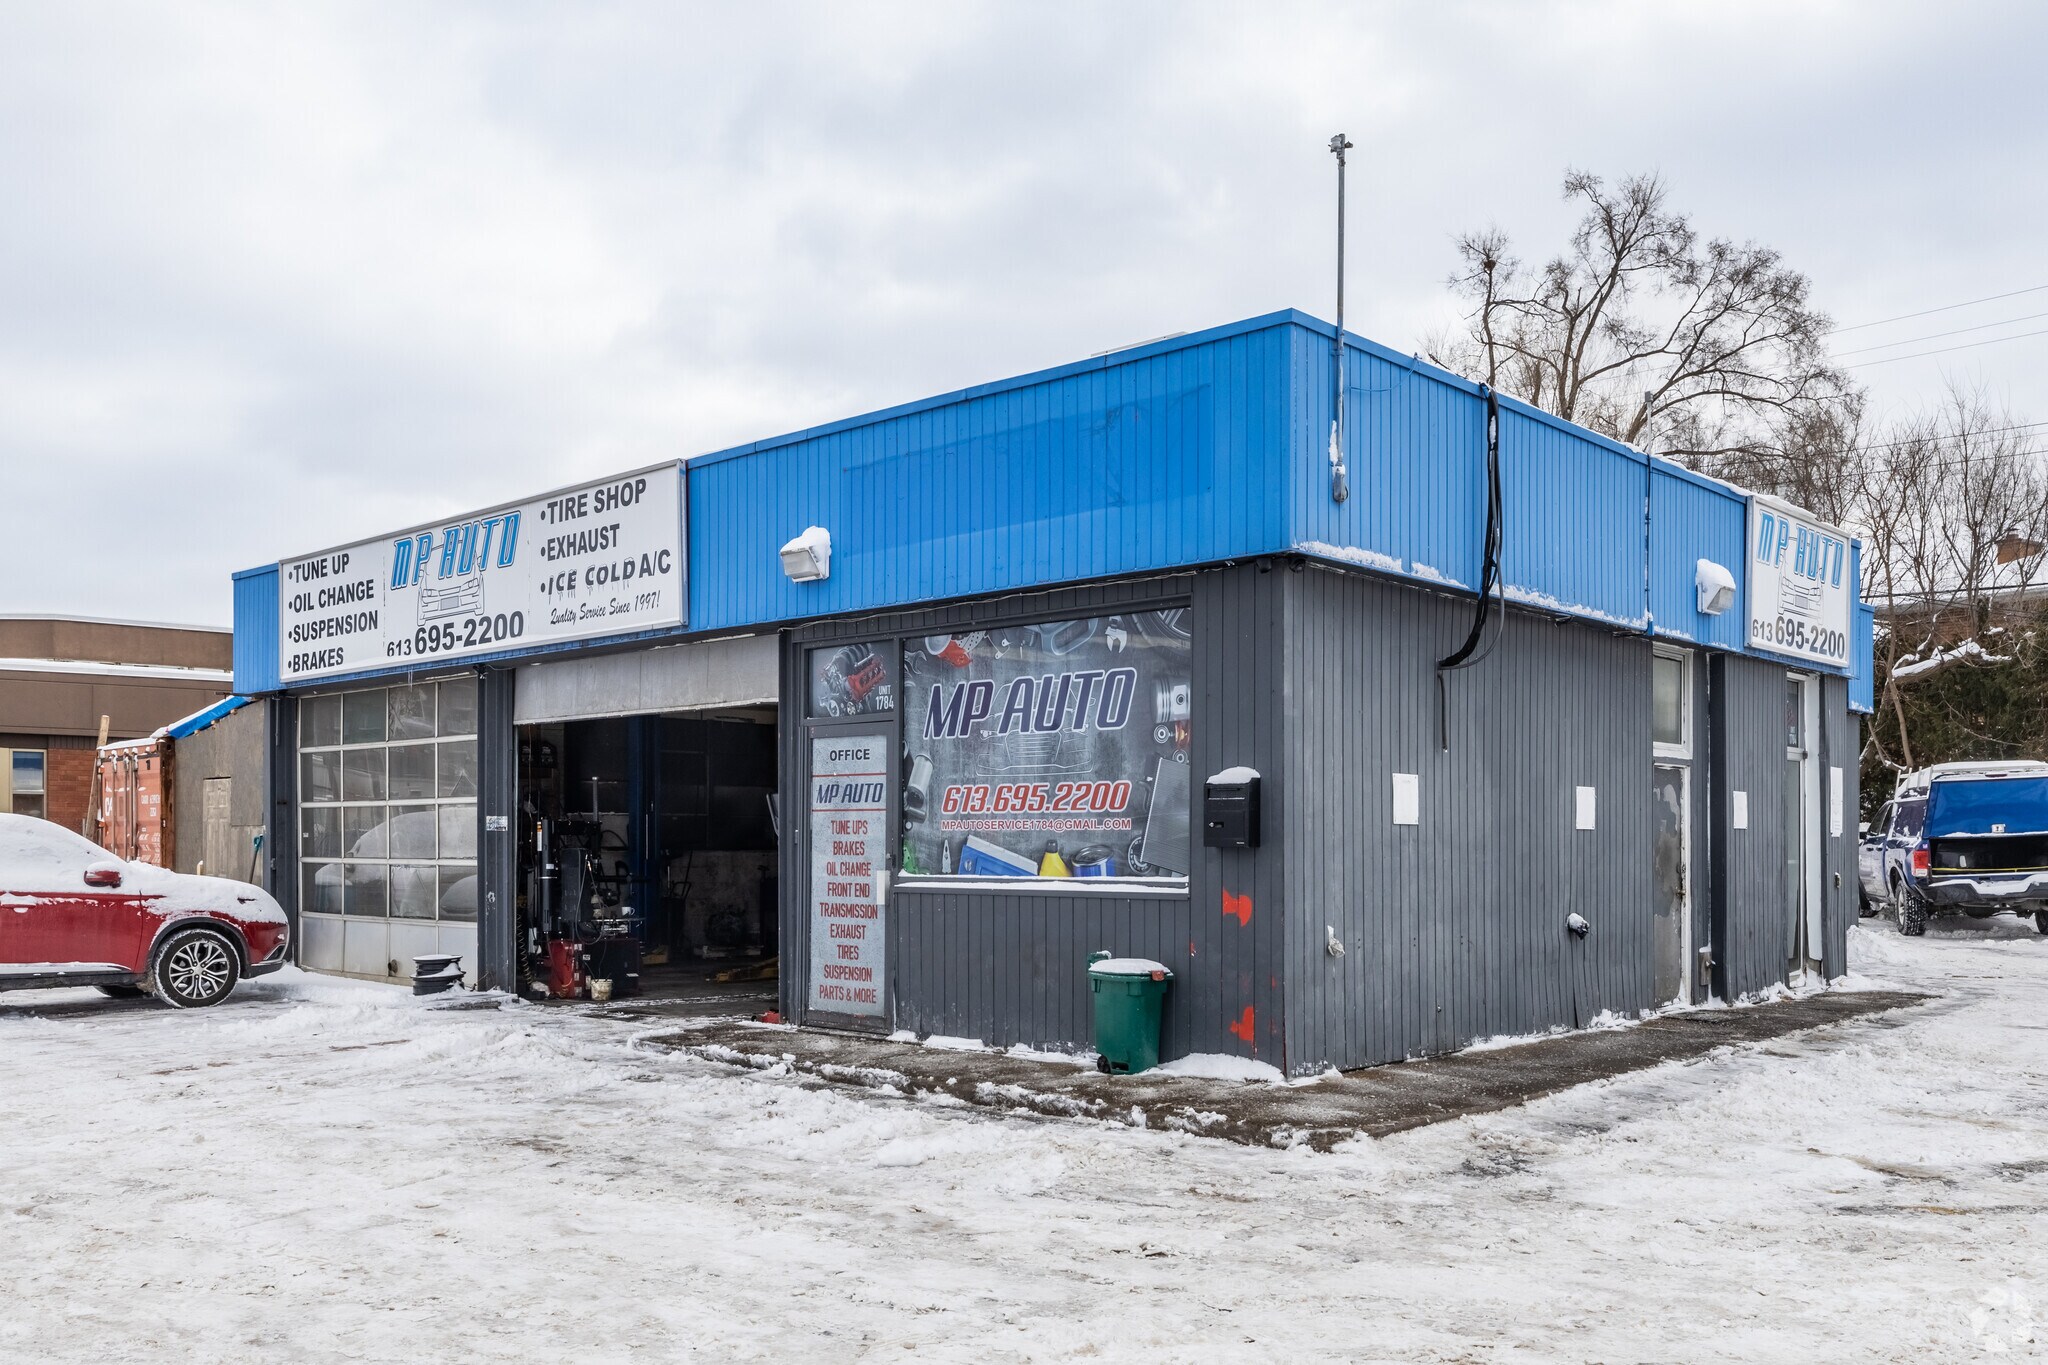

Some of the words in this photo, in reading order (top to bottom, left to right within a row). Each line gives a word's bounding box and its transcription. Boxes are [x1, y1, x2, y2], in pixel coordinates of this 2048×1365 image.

[547, 493, 588, 525] TIRE
[593, 478, 647, 514] SHOP
[390, 532, 433, 590] MP
[438, 510, 521, 580] AUTO
[547, 523, 620, 562] EXHAUST
[1756, 508, 1790, 569] MP
[1793, 522, 1845, 590] AUTO
[293, 558, 328, 583] TUNE
[332, 553, 350, 575] UP
[548, 569, 578, 596] ICE
[584, 557, 636, 587] COLD
[638, 549, 672, 579] A/C
[293, 592, 315, 613] OIL
[318, 579, 374, 608] CHANGE
[550, 608, 577, 625] Quality
[579, 602, 607, 620] Service
[609, 597, 631, 615] Since
[634, 590, 661, 612] 1997!
[293, 610, 378, 643] SUSPENSION
[386, 638, 412, 657] 613
[414, 610, 524, 655] 695-2200
[1752, 618, 1773, 642] 613
[1775, 616, 1846, 660] 695-2200
[292, 647, 344, 673] BRAKES
[879, 685, 892, 695] UNIT
[876, 696, 895, 710] 1784
[923, 679, 995, 739] MP
[997, 667, 1138, 736] AUTO
[829, 749, 871, 761] OFFICE
[816, 784, 839, 804] MP
[841, 783, 884, 803] AUTO
[941, 780, 1132, 815] 613.695.2200
[830, 820, 851, 835] TUNE
[852, 820, 868, 835] UPS
[941, 818, 1132, 833] MPAUTOSERVICE1784@GMAIL.COM
[833, 841, 865, 856] BRAKES
[826, 862, 838, 877] OIL
[840, 862, 871, 877] CHANGE
[827, 883, 852, 898] FRONT
[854, 883, 870, 898] END
[819, 902, 878, 920] TRANSMISSION
[830, 923, 866, 940] EXHAUST
[837, 945, 859, 961] TIRES
[824, 964, 872, 983] SUSPENSION
[819, 985, 844, 1001] PARTS
[846, 988, 852, 1002] &
[854, 987, 877, 1004] MORE
